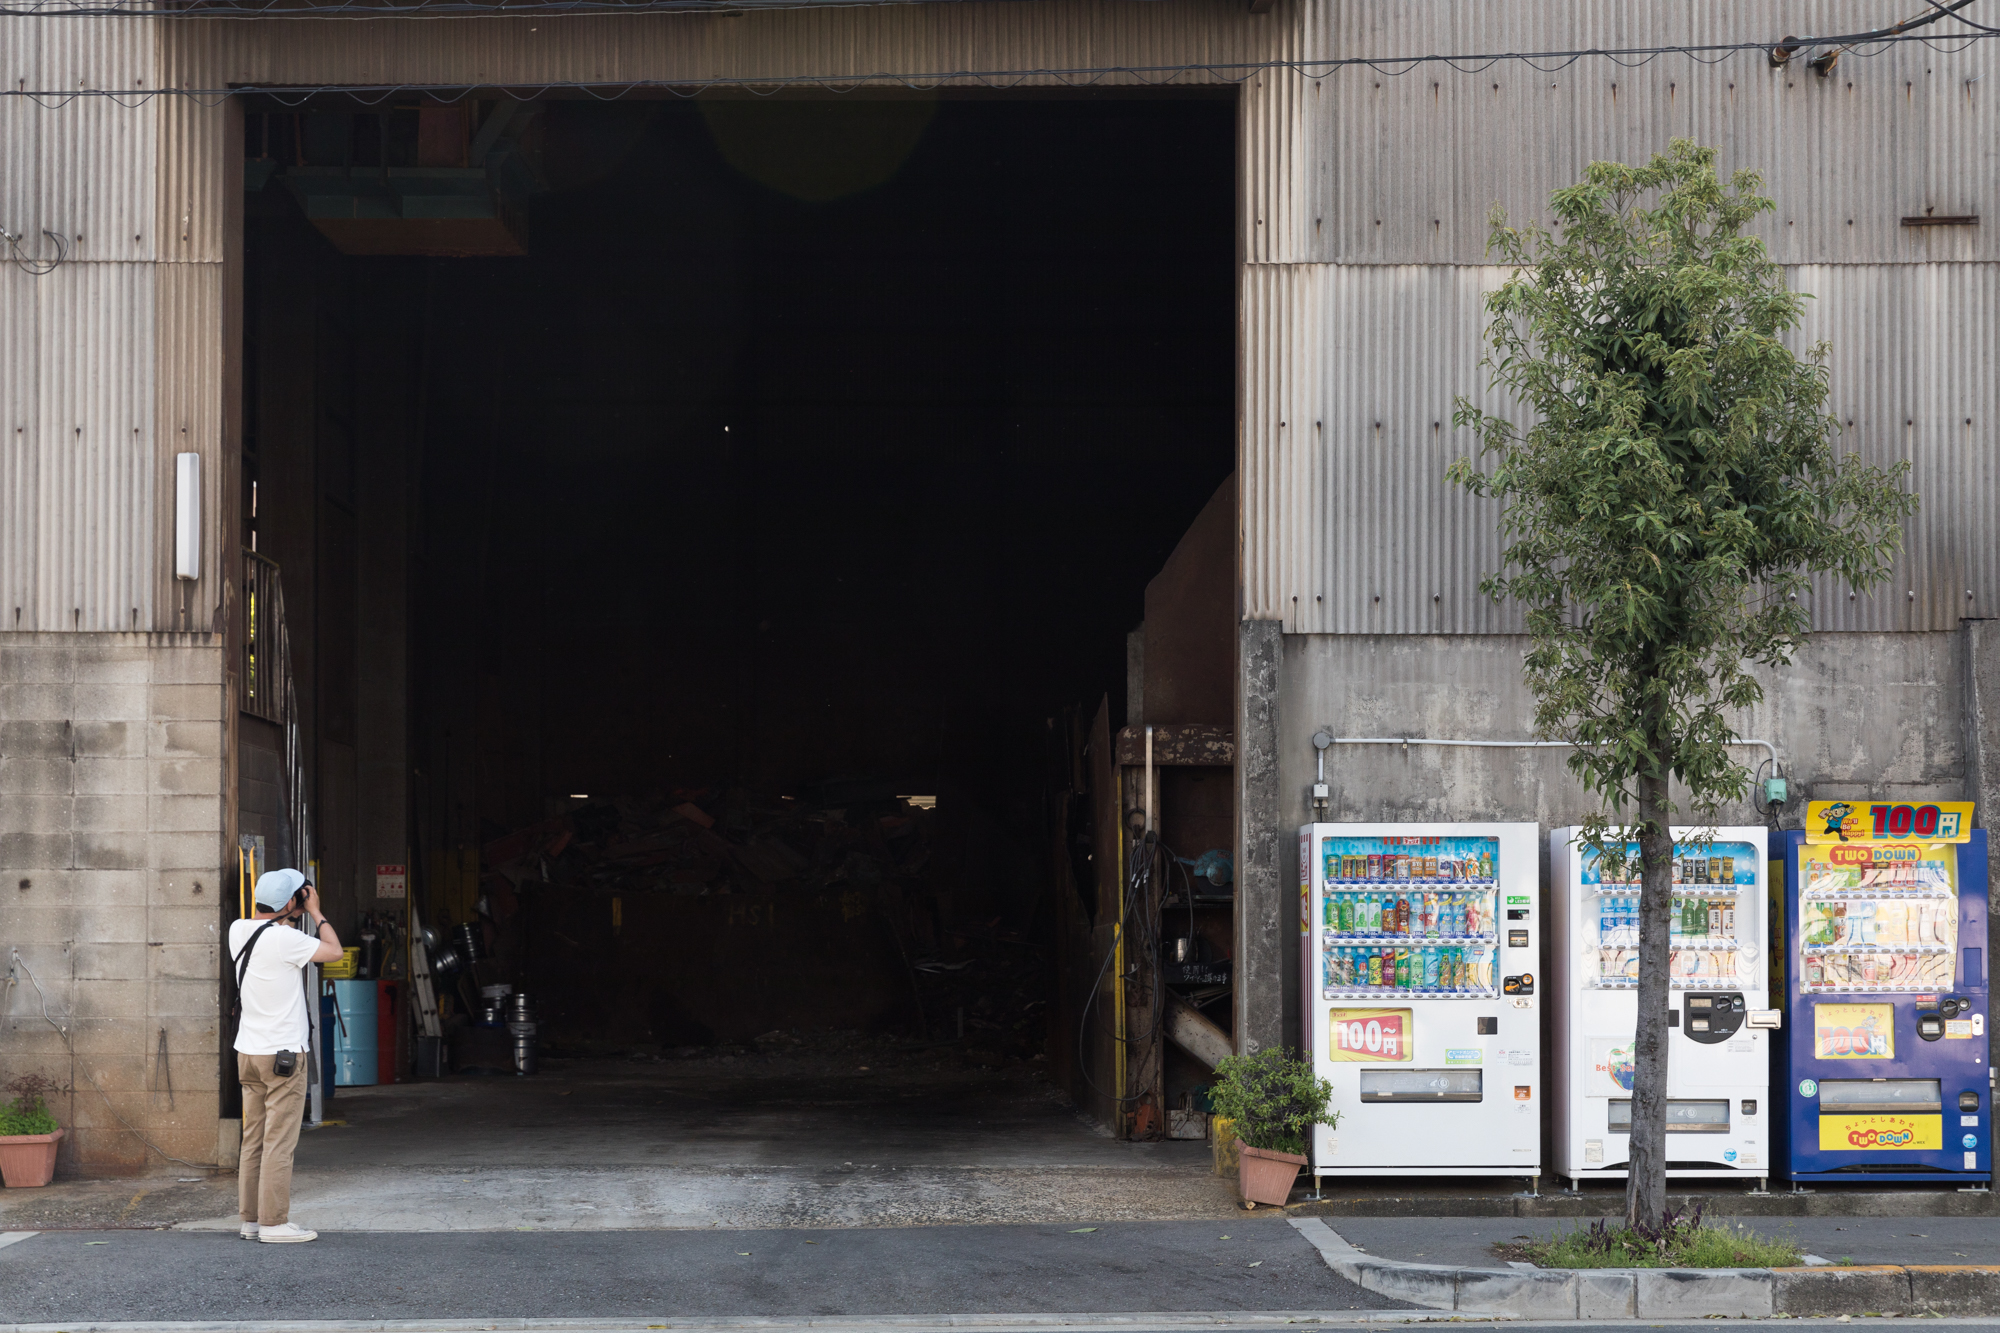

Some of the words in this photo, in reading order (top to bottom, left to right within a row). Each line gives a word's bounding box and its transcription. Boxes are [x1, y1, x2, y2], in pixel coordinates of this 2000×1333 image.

[1870, 805, 1961, 840] 100円
[1841, 830, 1865, 838] Happy!
[1835, 850, 1868, 861] TWO
[1874, 850, 1916, 861] DOWN
[1819, 1007, 1883, 1020] ちょっとしあわせ
[1818, 1026, 1887, 1056] 100円
[1596, 1064, 1616, 1072] Best
[1845, 1116, 1914, 1131] ちょっとしあわせ
[1852, 1132, 1876, 1145] TWO
[1879, 1132, 1909, 1143] DOWN
